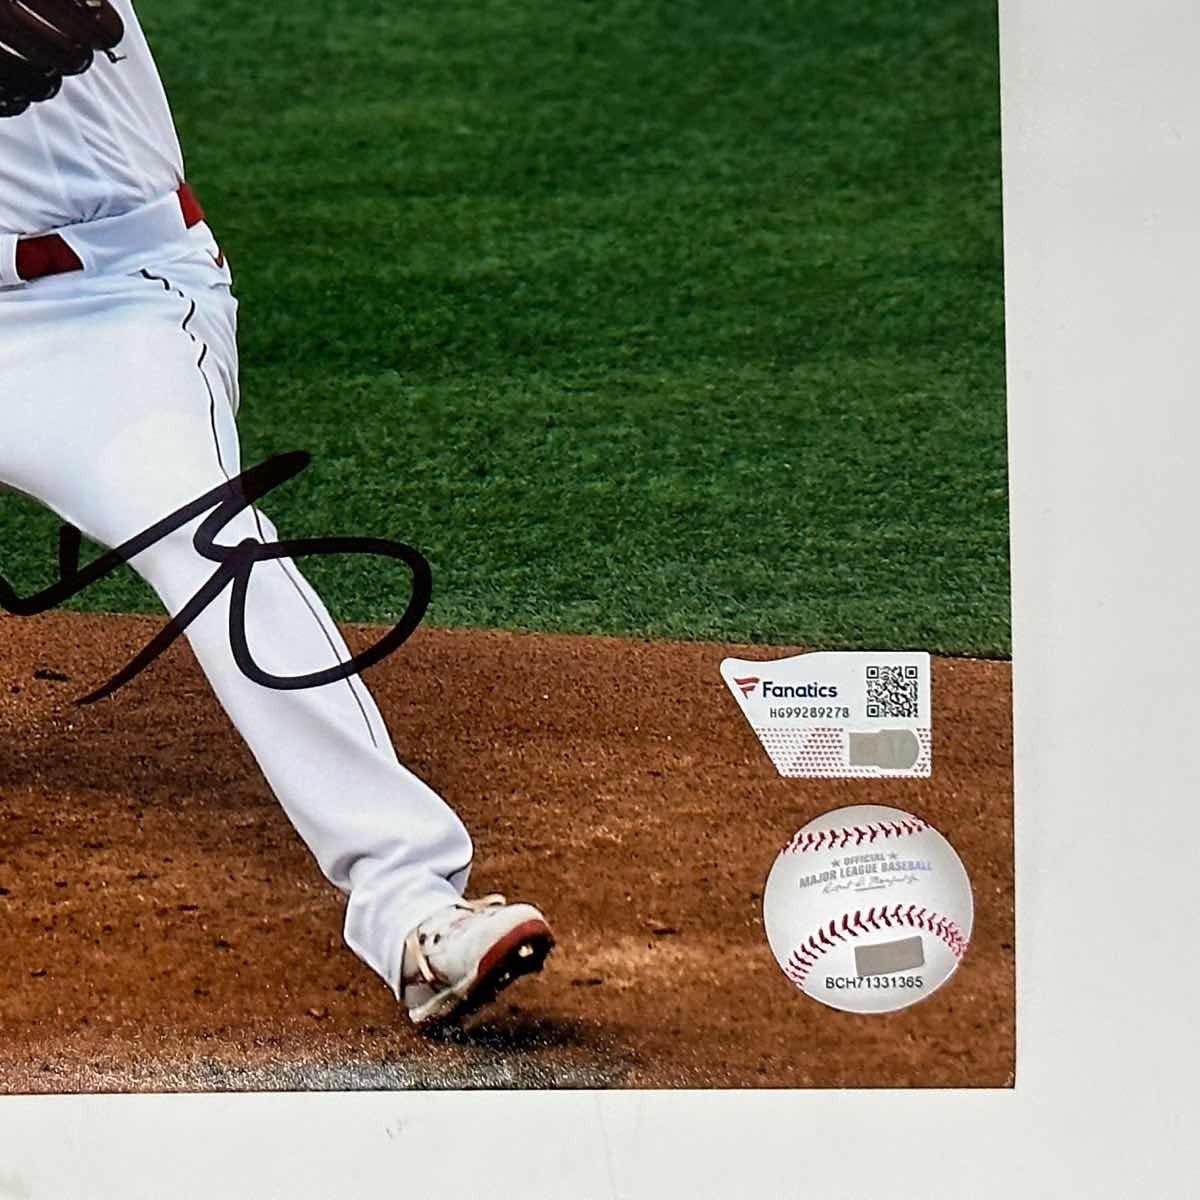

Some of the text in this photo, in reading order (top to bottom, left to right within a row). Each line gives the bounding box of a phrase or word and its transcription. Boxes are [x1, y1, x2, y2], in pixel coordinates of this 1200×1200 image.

[762, 681, 838, 699] Fanatics
[769, 706, 850, 719] HG99289278
[843, 852, 886, 867] OFFICIAL
[799, 869, 837, 889] MAJOR
[839, 864, 878, 879] LEAGUE
[880, 859, 933, 874] BASEBALL
[825, 975, 924, 990] BCH71331365
